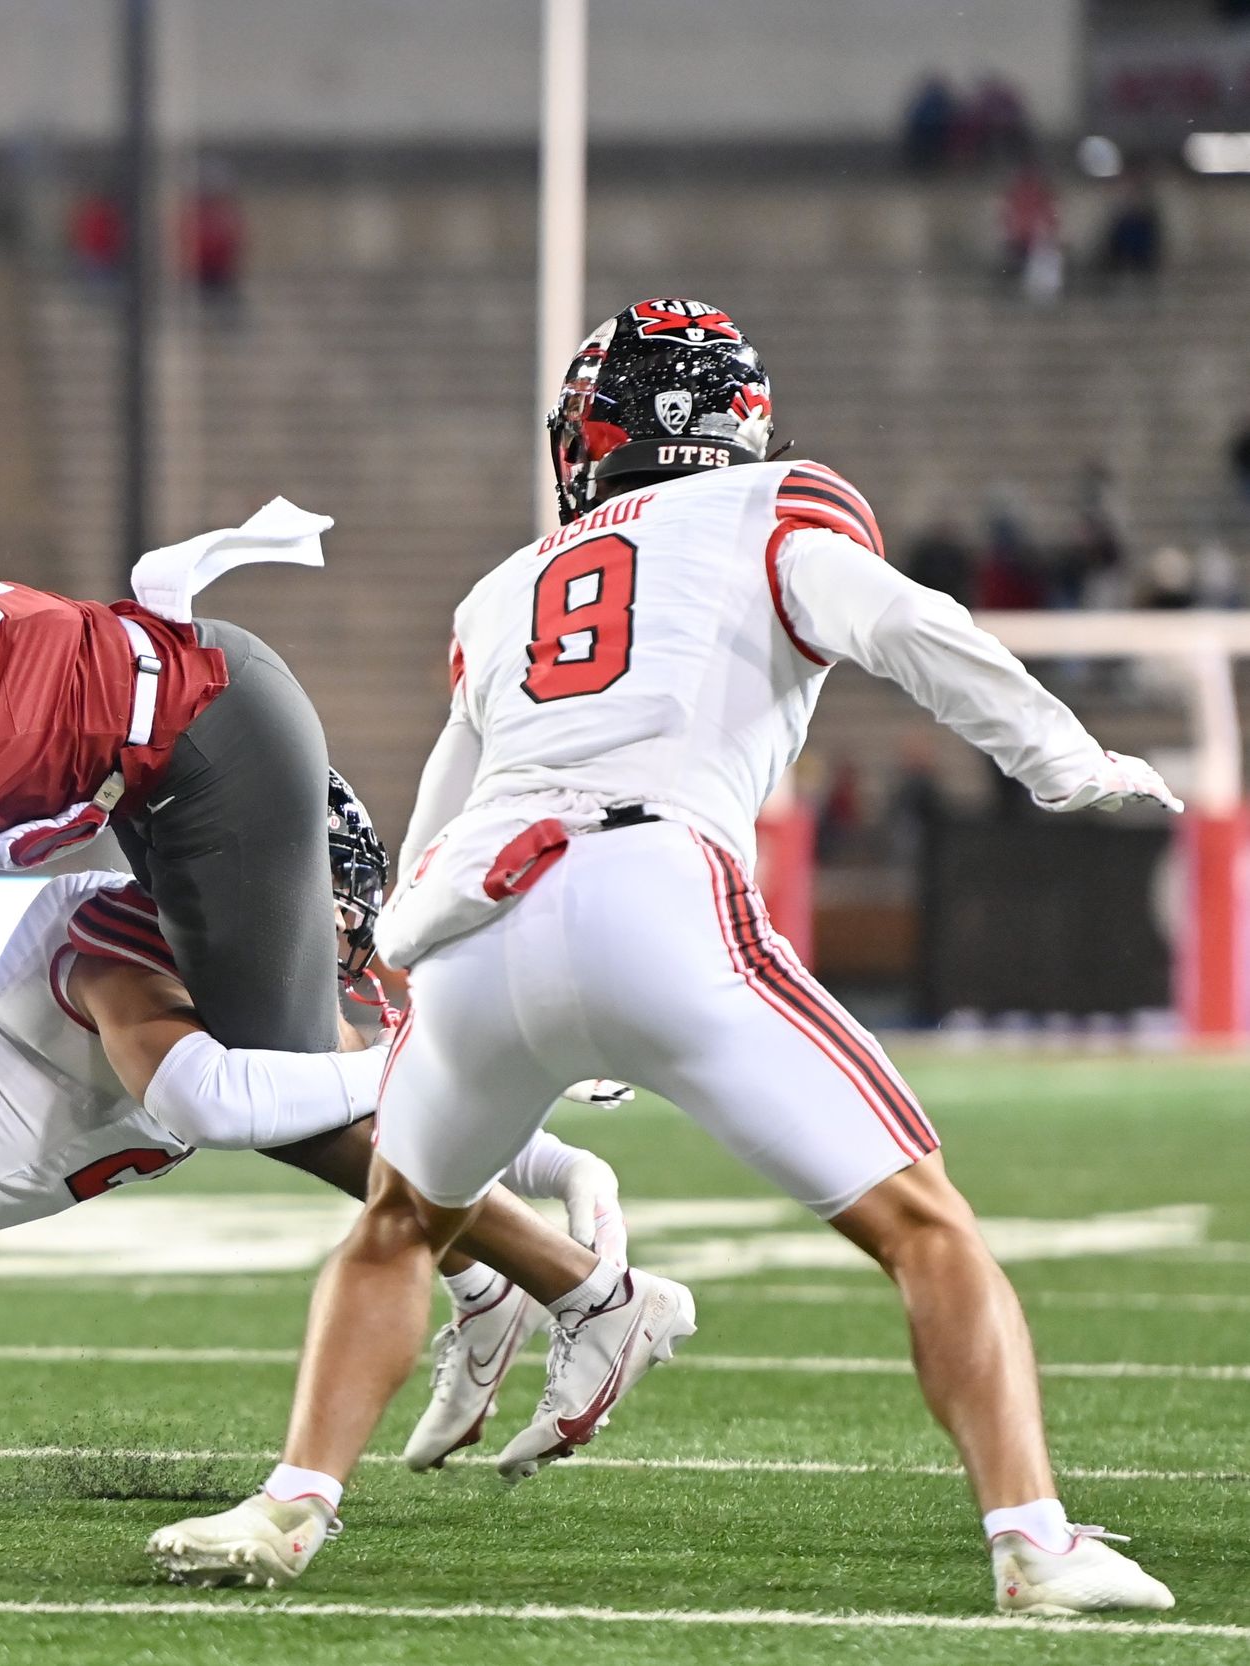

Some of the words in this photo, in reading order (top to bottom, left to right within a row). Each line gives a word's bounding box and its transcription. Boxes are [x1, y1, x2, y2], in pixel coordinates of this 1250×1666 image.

[685, 328, 705, 342] U
[666, 410, 687, 426] 12
[657, 445, 731, 468] UTES
[536, 492, 660, 556] BISHOP
[519, 532, 639, 704] 8
